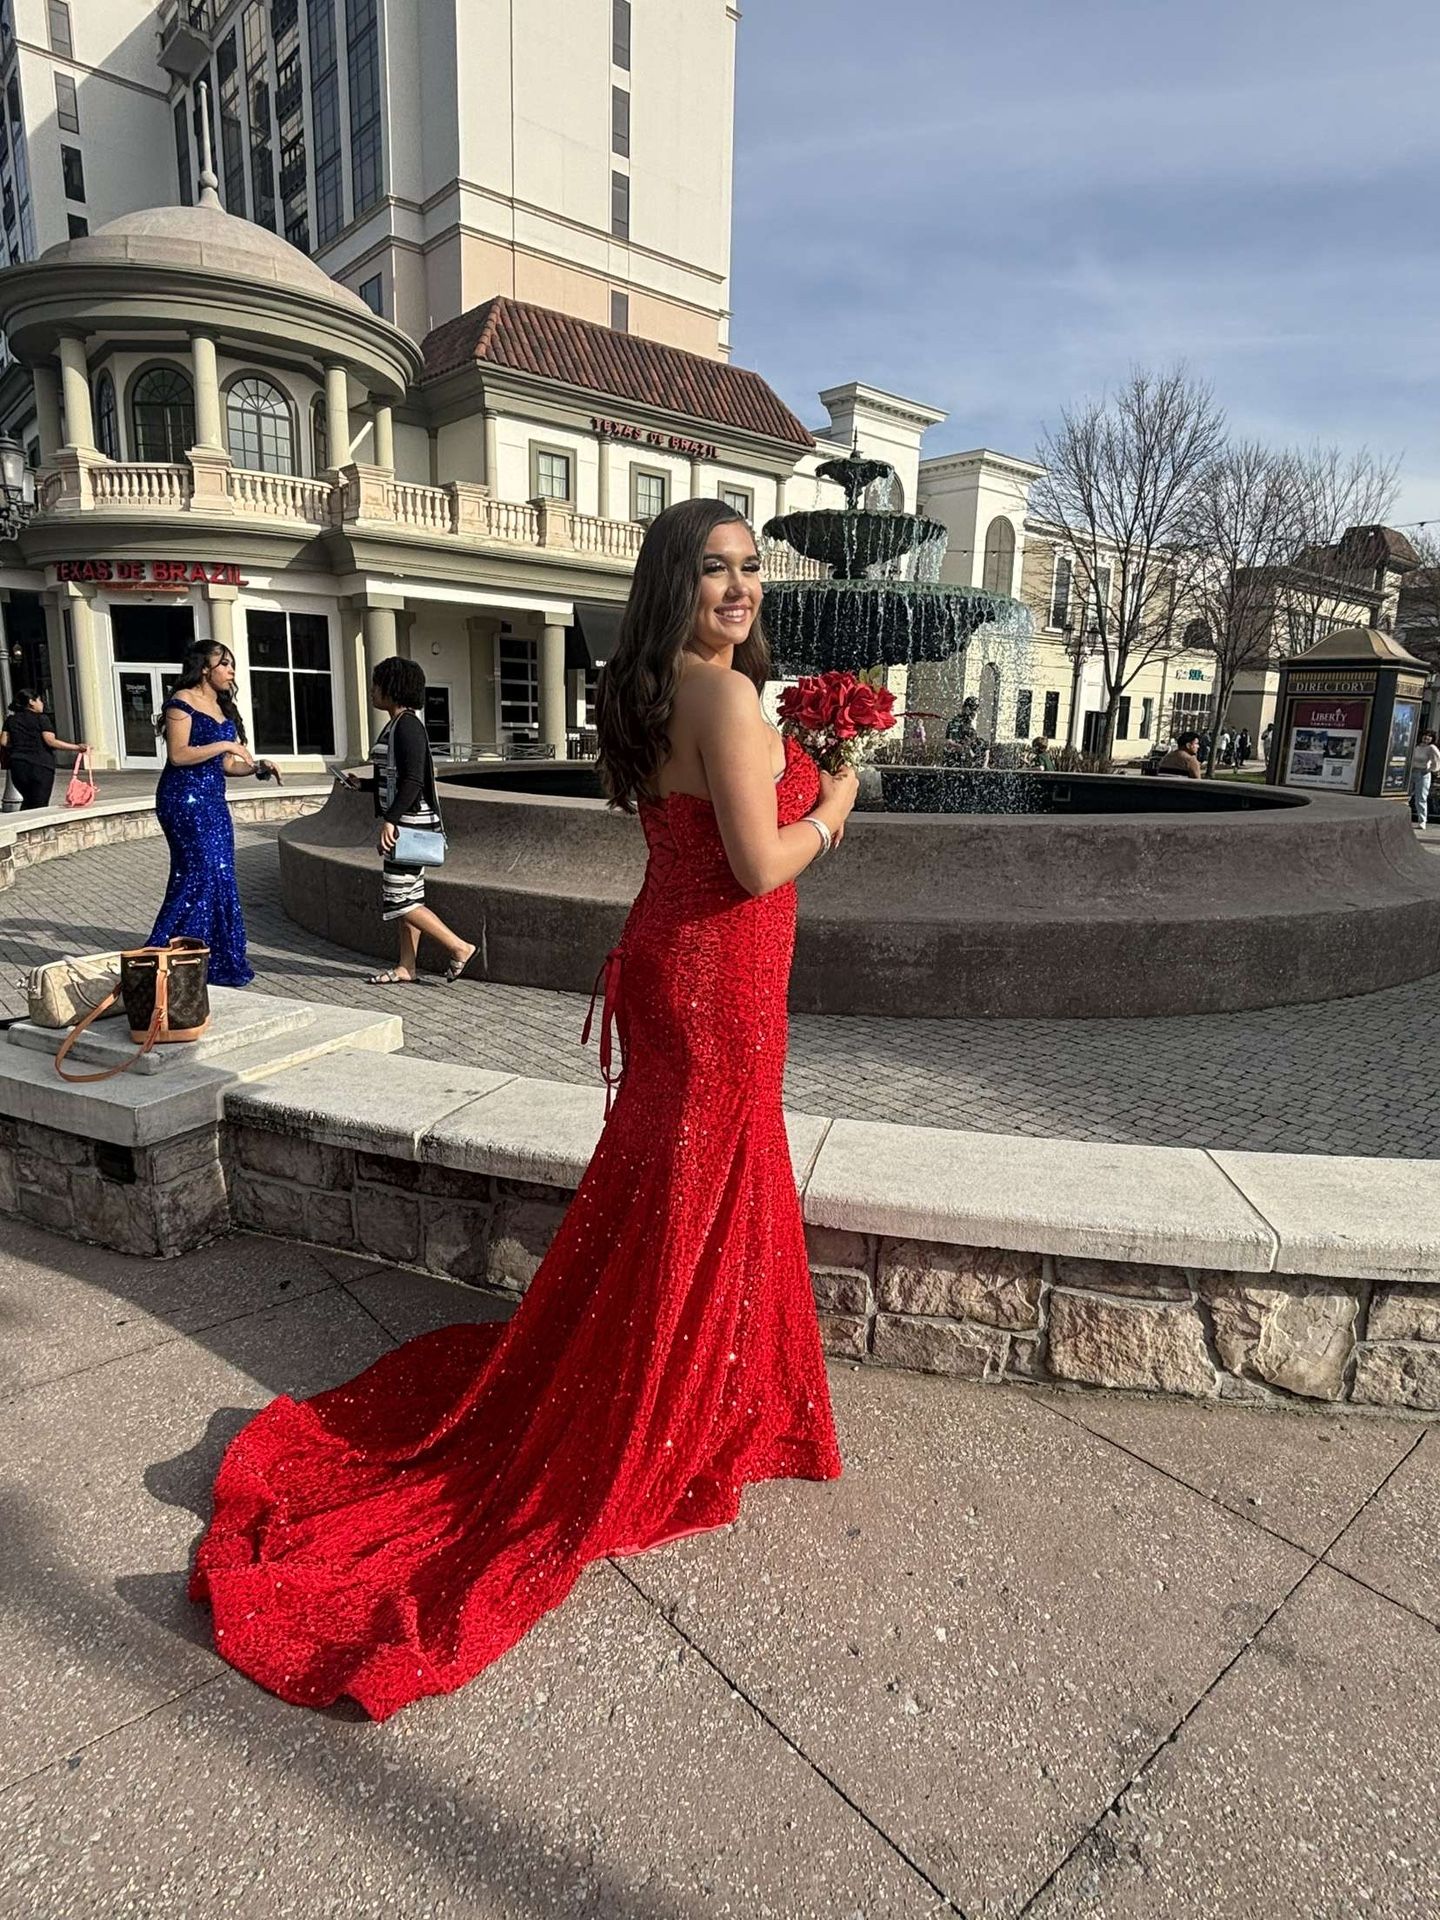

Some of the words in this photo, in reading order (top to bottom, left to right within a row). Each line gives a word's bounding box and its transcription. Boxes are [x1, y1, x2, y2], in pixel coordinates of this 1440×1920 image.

[591, 417, 642, 440] TEXAS
[669, 436, 719, 458] BRAZIL
[116, 561, 146, 580] DE
[152, 562, 249, 586] BRAZIL
[1296, 682, 1365, 691] DIRECTORY
